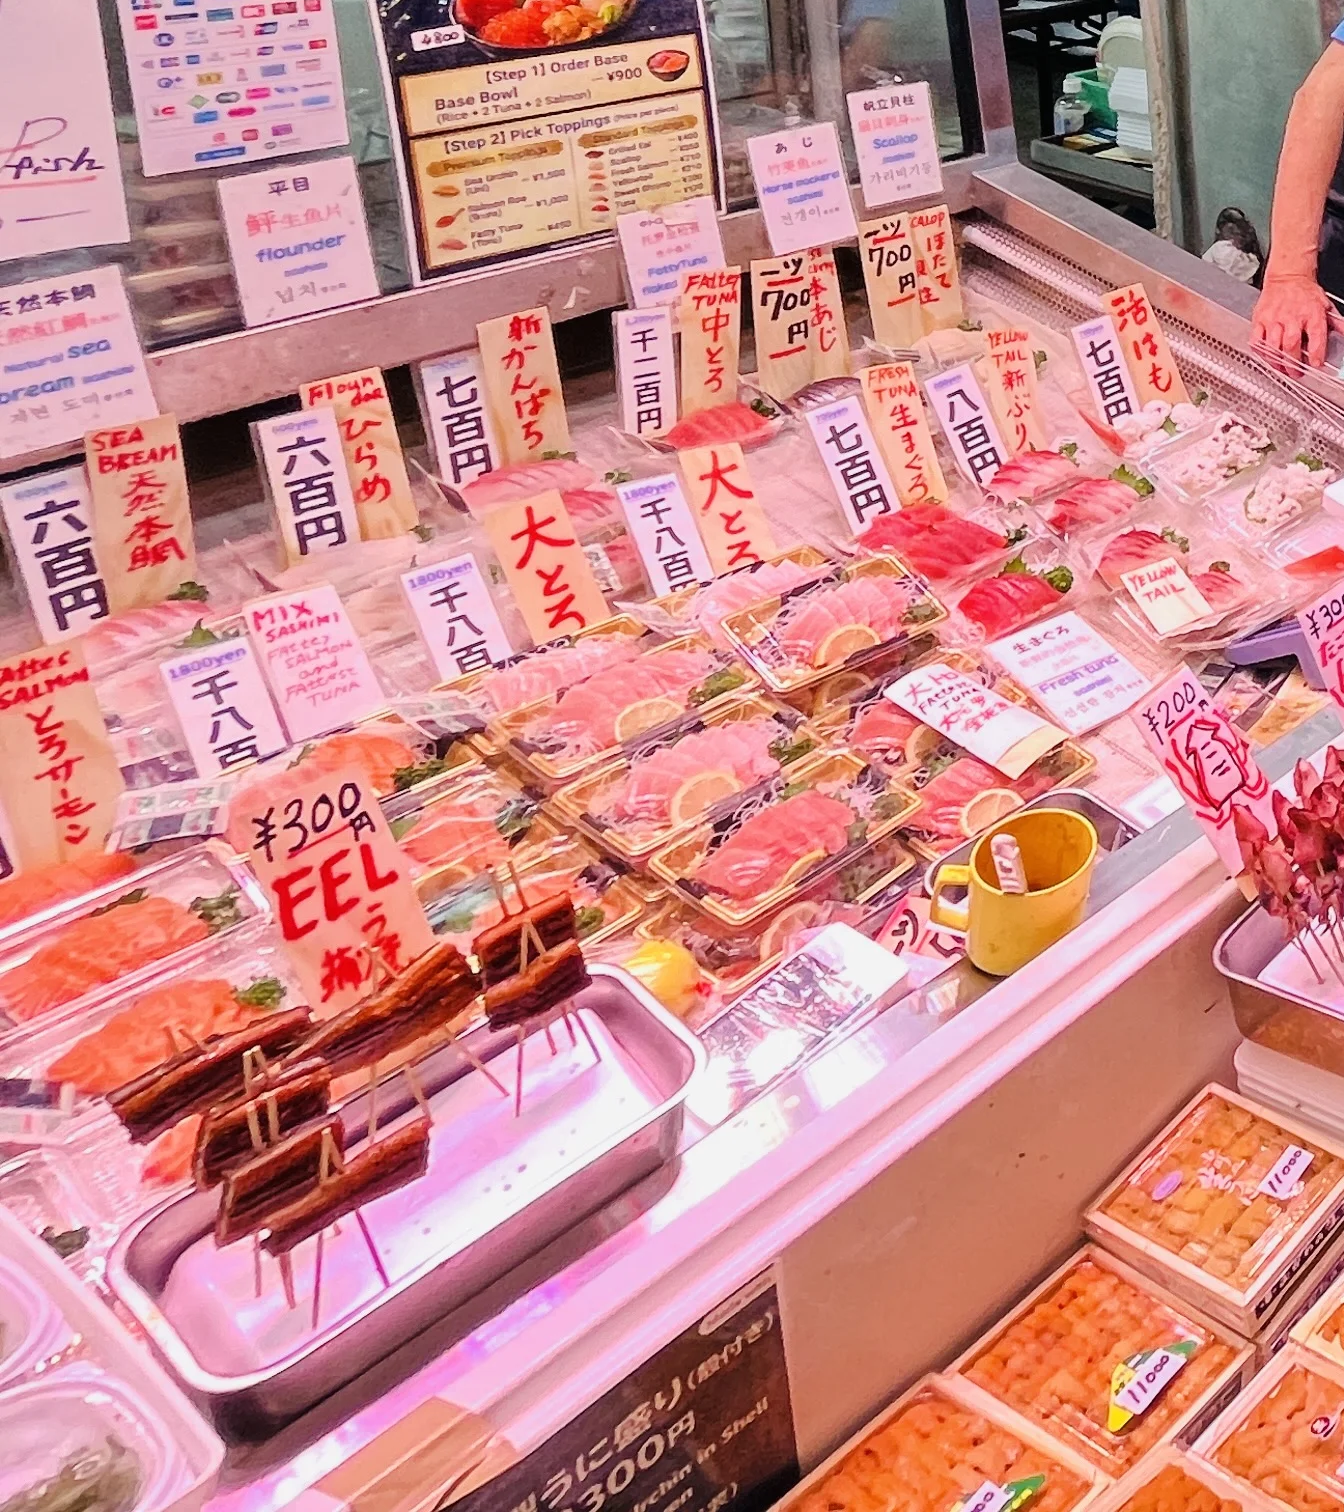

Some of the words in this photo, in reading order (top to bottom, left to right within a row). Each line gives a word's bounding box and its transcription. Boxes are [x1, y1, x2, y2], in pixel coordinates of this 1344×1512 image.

[420, 28, 462, 49] 4800
[550, 57, 590, 74] Order
[594, 52, 629, 68] Base
[435, 94, 476, 111] Base
[480, 86, 519, 104] Bowl
[510, 126, 543, 142] Pick
[547, 113, 611, 135] Toppings
[267, 176, 311, 197] 平目
[255, 232, 348, 265] flounder
[868, 244, 912, 278] 700
[898, 272, 916, 295] 円
[692, 290, 739, 312] TUNA
[760, 287, 811, 322] 700
[787, 318, 809, 345] 円
[67, 338, 112, 359] sea
[701, 307, 731, 394] 中とろ
[991, 350, 1029, 369] TAIL
[630, 327, 663, 434] 千二百円
[867, 365, 911, 388] FRESH
[872, 381, 919, 404] TUNA
[1086, 339, 1134, 426] 七百円
[90, 426, 145, 451] SEA
[437, 373, 494, 485] 七百円
[946, 388, 1004, 484] 八百円
[97, 443, 179, 475] BREAM
[340, 415, 393, 505] ひらめ
[889, 403, 931, 503] 生まぐろ
[825, 421, 892, 524] 七百円
[275, 436, 347, 556] 六百円
[699, 450, 762, 575] 大とろ
[23, 498, 111, 633] 六百円
[406, 560, 474, 589] 1800yen
[510, 505, 586, 630] 大とろ
[1127, 563, 1178, 591] YELLOW
[1143, 580, 1185, 604] TAIL
[252, 600, 313, 633] MIX
[265, 611, 341, 644] SASHIMI
[168, 647, 248, 682] 1800yen
[284, 640, 354, 669] SALMON
[299, 655, 339, 680] and
[306, 681, 361, 707] TUNA
[1038, 665, 1086, 695] Fresh
[271, 843, 400, 942] EEL
[1267, 1149, 1303, 1194] 11000
[1126, 1351, 1171, 1407] 11000
